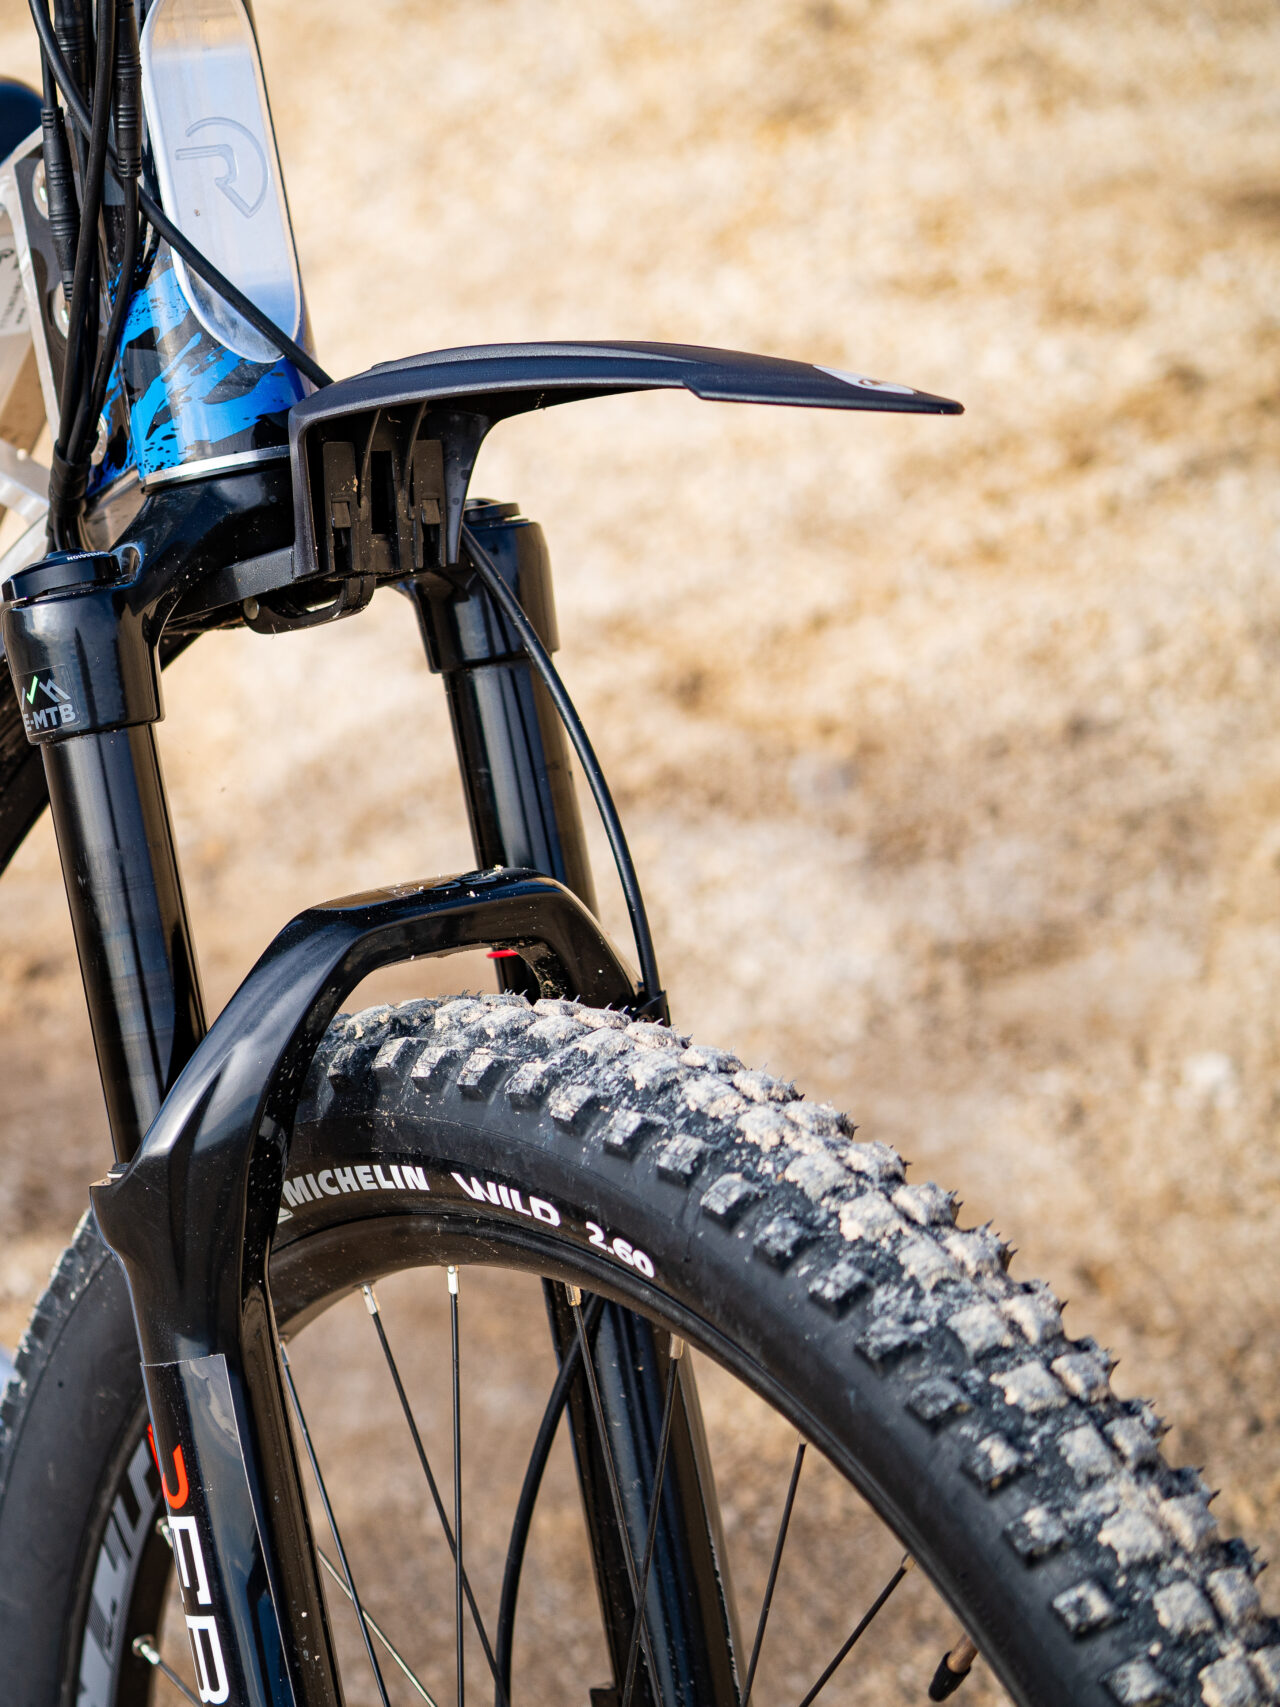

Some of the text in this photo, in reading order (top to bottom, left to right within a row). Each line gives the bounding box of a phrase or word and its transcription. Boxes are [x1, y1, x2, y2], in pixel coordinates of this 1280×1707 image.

[282, 1164, 655, 1279] MICHELIN WILD 2.60
